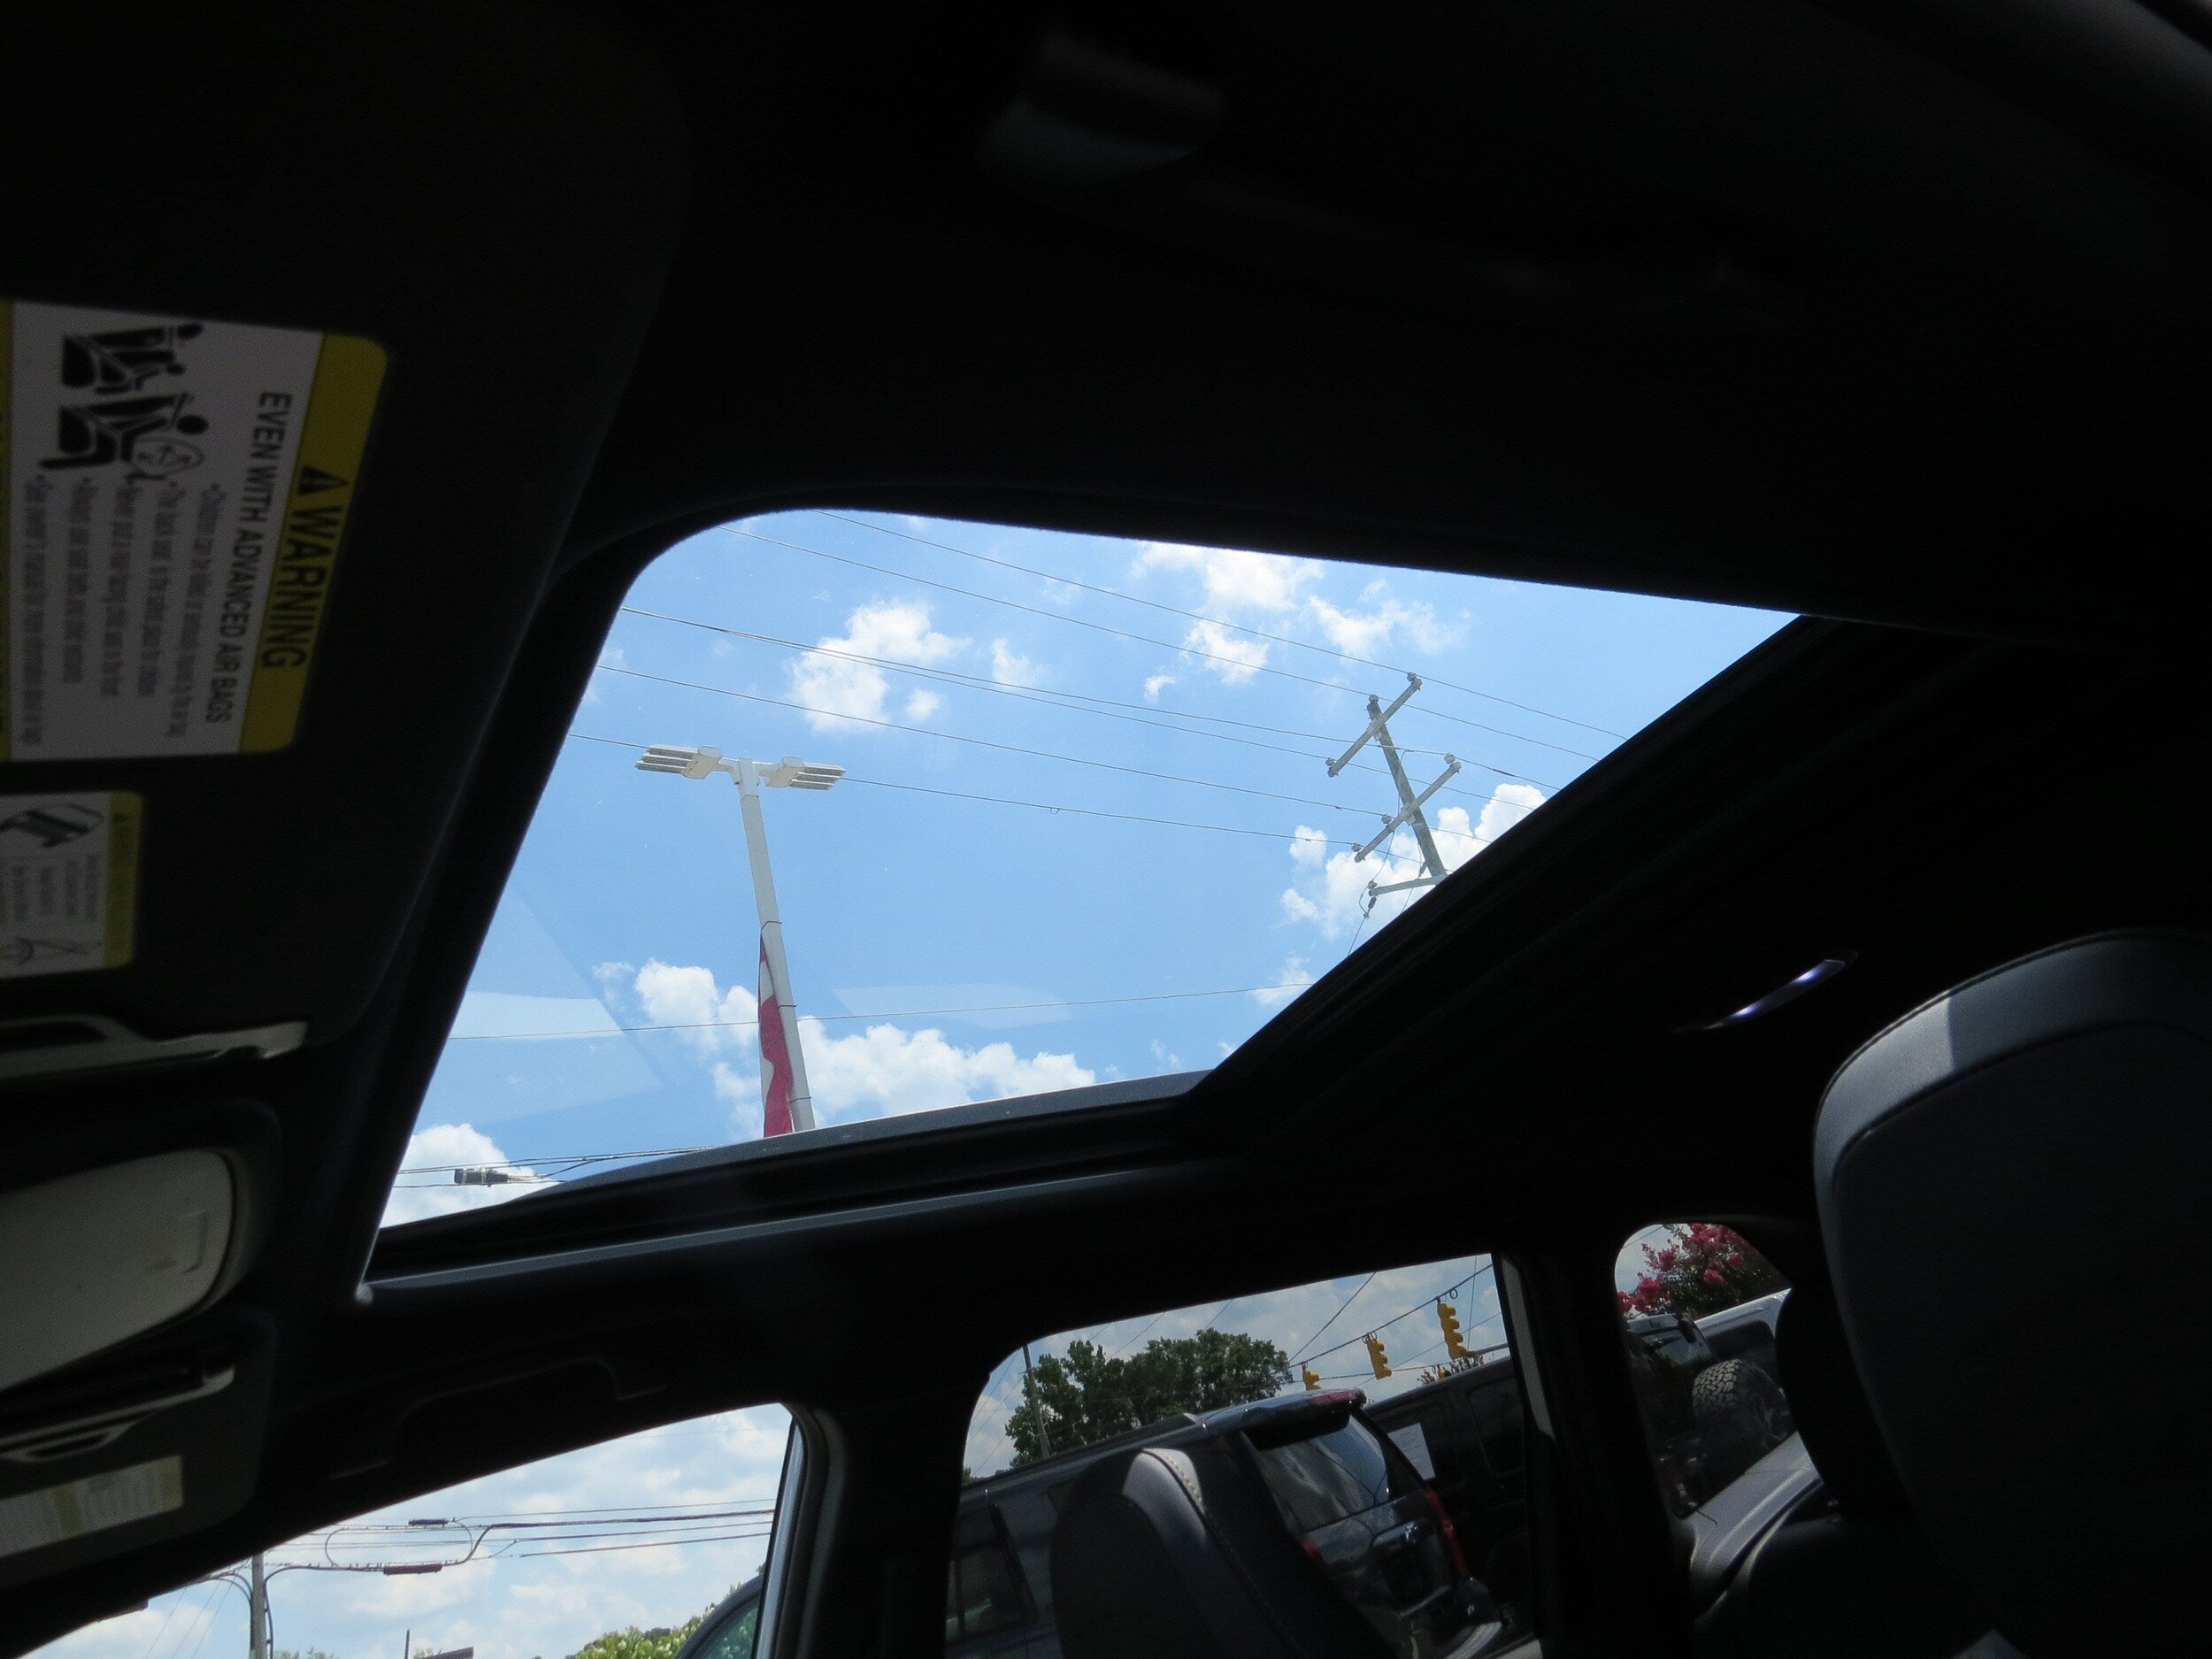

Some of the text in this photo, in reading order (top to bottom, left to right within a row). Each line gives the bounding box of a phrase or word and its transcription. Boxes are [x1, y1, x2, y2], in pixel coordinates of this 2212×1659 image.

[205, 392, 292, 724] EVEN WITH ADVANCED AIR BAGS
[262, 505, 342, 669] WARNING
